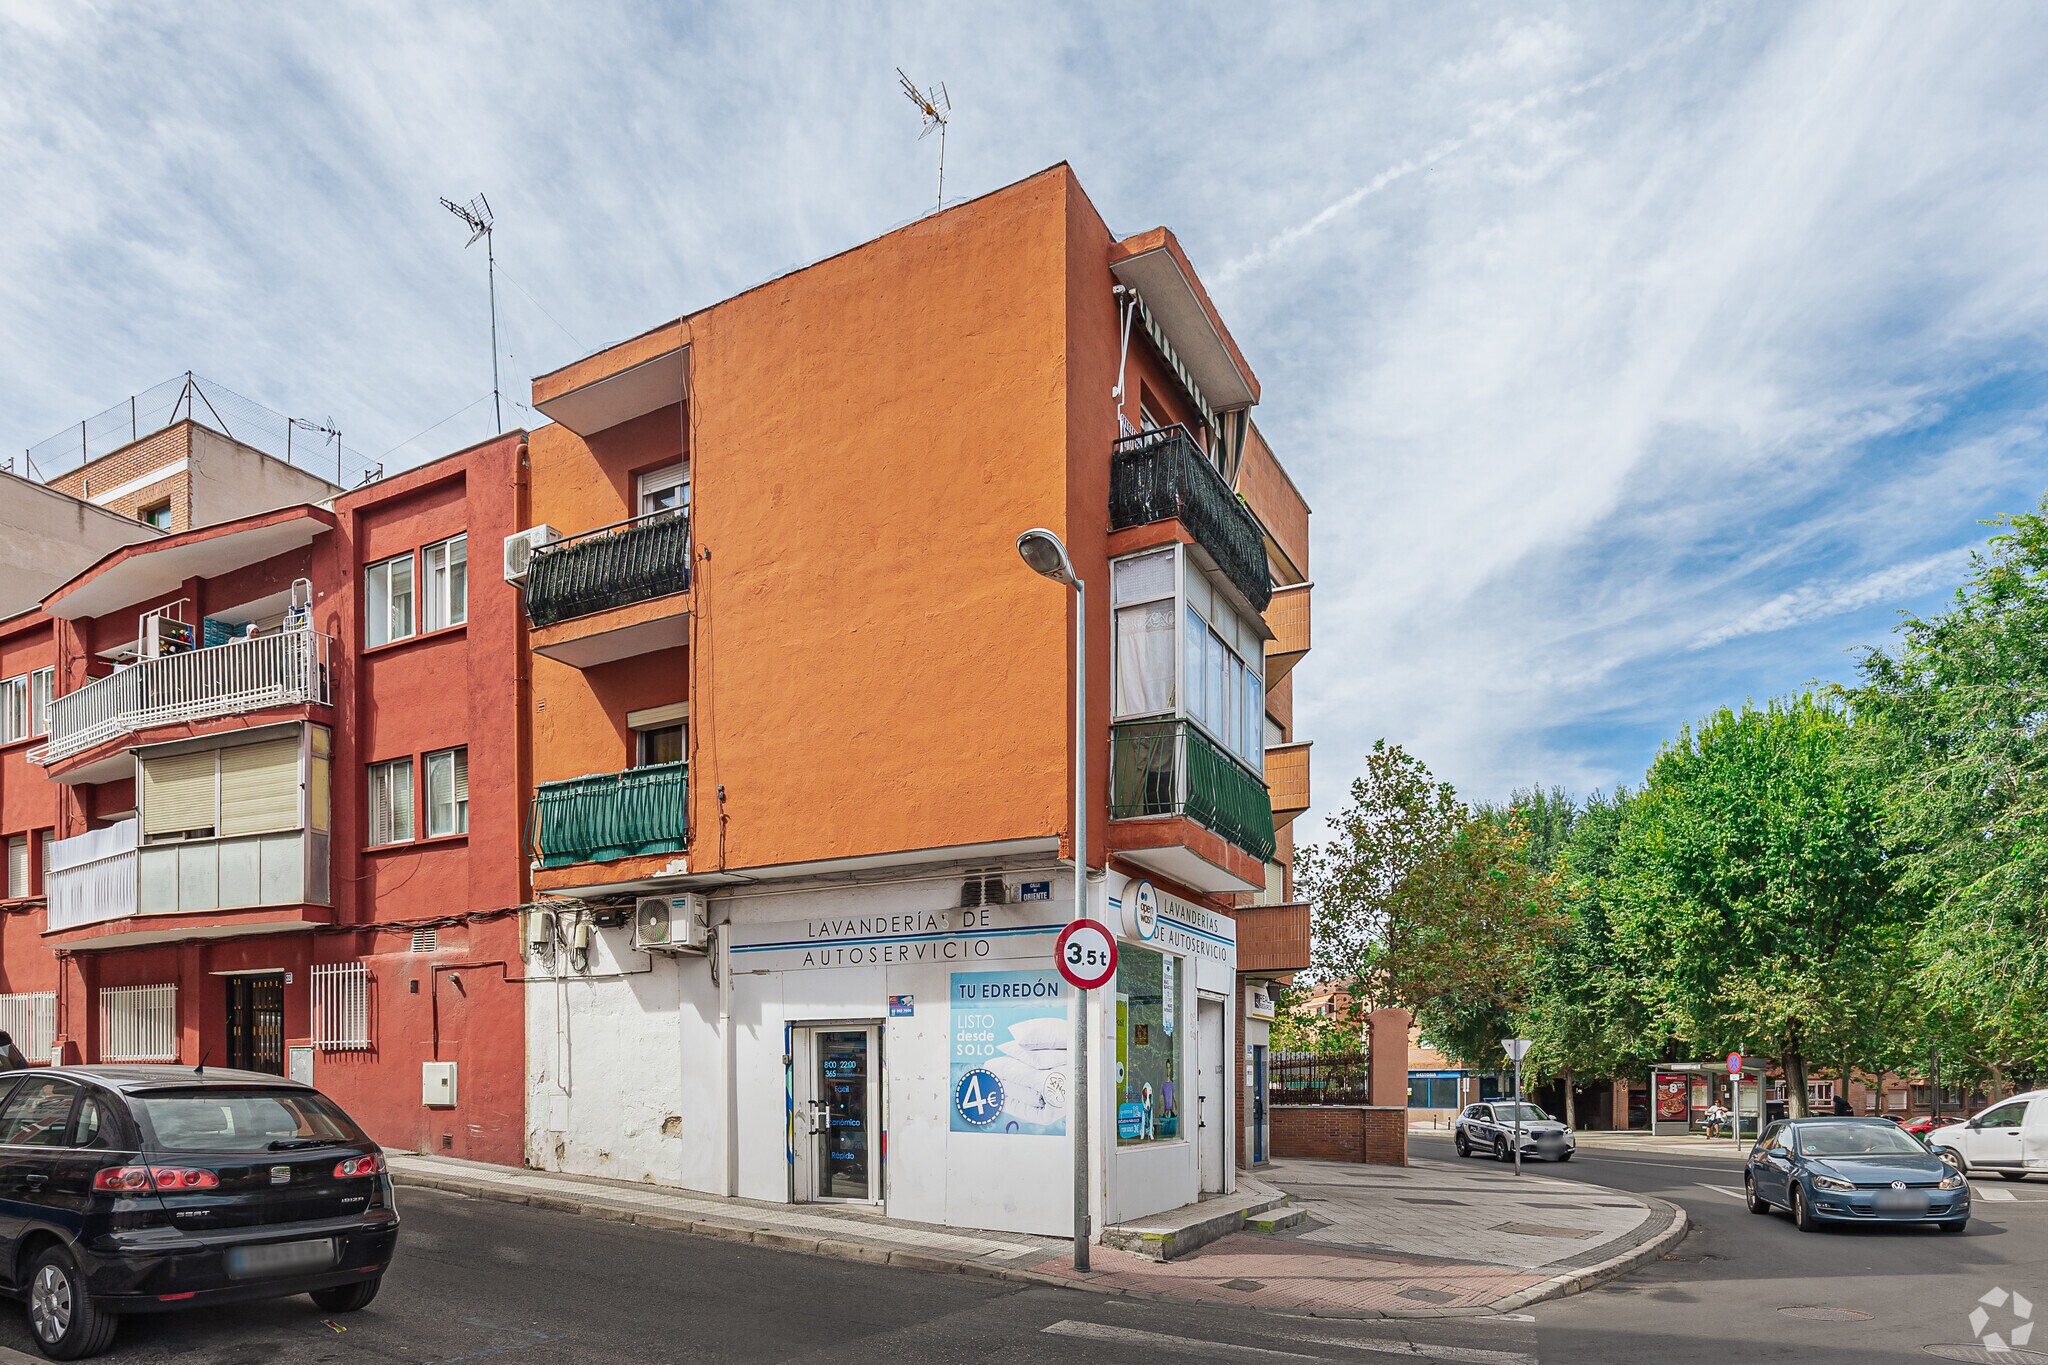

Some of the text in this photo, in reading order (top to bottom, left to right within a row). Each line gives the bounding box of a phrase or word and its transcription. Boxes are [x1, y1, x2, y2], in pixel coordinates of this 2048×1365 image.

[1023, 891, 1048, 901] ORIENTE
[1140, 902, 1154, 915] open
[963, 909, 990, 928] DE
[1140, 914, 1154, 926] wash
[1164, 899, 1219, 933] LAVANDERÍAS
[1153, 925, 1227, 961] DE AUTOSERVICIO
[803, 939, 990, 967] AUTOSERVICIO
[959, 978, 1059, 999] TU EDREDÓN
[957, 1014, 995, 1029] LISTO
[956, 1029, 995, 1042] desde
[956, 1044, 995, 1056] SOLO
[839, 1060, 857, 1069] 22:00
[825, 1070, 837, 1078] 365
[341, 1196, 365, 1204] IBIZA
[176, 1210, 210, 1218] SEAT
